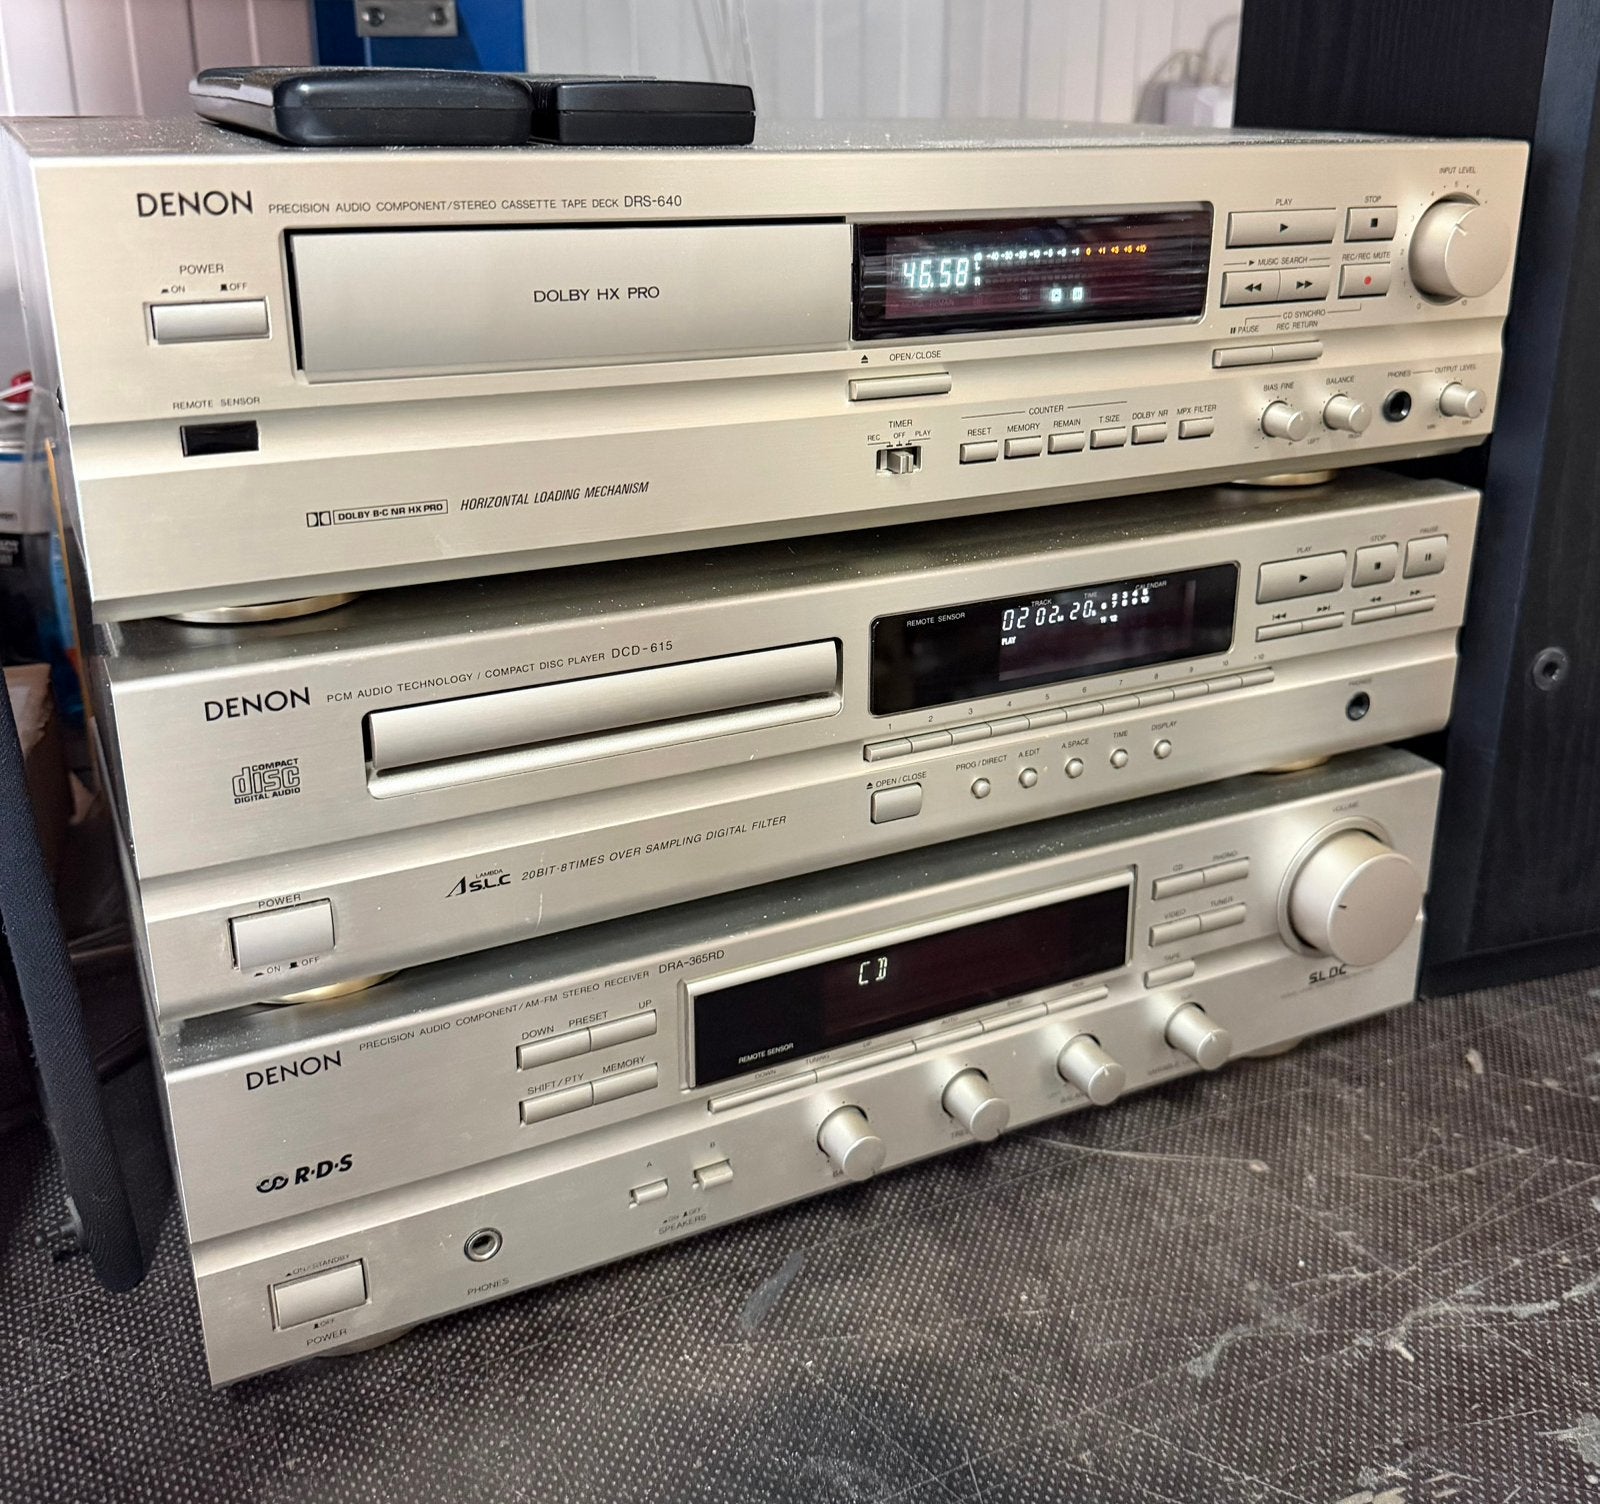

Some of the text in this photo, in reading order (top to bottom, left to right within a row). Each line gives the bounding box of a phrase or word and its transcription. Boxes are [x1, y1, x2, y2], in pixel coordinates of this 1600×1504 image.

[1458, 166, 1477, 174] LEVEL
[136, 190, 254, 218] DENON
[268, 194, 682, 214] PRECISION AUDIO COMPONENT/STEREO CASSETTE TAPE DECK DRS-640
[1275, 198, 1294, 206] PLAY
[1364, 195, 1382, 204] STOP
[1257, 256, 1308, 266] MUSIC SEARCH
[1373, 251, 1391, 259] MUTE
[179, 263, 225, 275] POWER
[902, 257, 970, 289] 46.58
[170, 282, 248, 294] ON OFF
[533, 286, 660, 303] DOLBY HX PRO
[1282, 309, 1326, 320] CD SYNCHRO
[1238, 325, 1259, 334] PAUSE
[1276, 320, 1318, 331] REC RETURN
[889, 350, 942, 361] OPEN/CLOSE
[1387, 370, 1412, 378] PHONES
[1434, 365, 1459, 374] OUTPUT
[1326, 375, 1355, 385] BALANCE
[1263, 382, 1295, 392] BIAS FINE
[172, 396, 261, 411] REMOTE SENSOR
[1028, 404, 1064, 415] COUNTER
[1194, 404, 1217, 413] FILTER
[1132, 409, 1169, 420] DOLBY NR
[889, 419, 913, 428] TIMER
[1007, 422, 1041, 433] MEMORY
[1053, 418, 1081, 428] REMAIN
[967, 427, 992, 437] RESET
[459, 481, 650, 511] HORIZONTAL LOADING MECHANISM
[338, 511, 370, 521] DOLBY
[390, 506, 406, 516] NR
[408, 505, 422, 513] HX
[423, 503, 443, 512] PRO
[1084, 591, 1098, 599] TIME
[1031, 599, 1053, 608] TRACK
[906, 611, 966, 627] REMOTE SENSOR
[1002, 606, 1030, 631] 02
[1001, 636, 1017, 646] PLAY
[326, 690, 353, 703] PCM
[357, 685, 393, 699] AUDIO
[396, 672, 473, 693] TECHNOLOGY
[485, 662, 535, 680] COMPACT
[539, 659, 564, 670] DISC
[568, 652, 606, 666] PLAYER
[204, 686, 311, 723] DENON
[1151, 720, 1178, 731] DISPLAY
[1113, 730, 1128, 739] TIME
[252, 758, 299, 772] COMPACT
[232, 766, 300, 797] disc
[234, 787, 300, 805] DIGITAL AUDIO
[609, 846, 642, 862] OVER
[645, 833, 702, 854] SAMPLING
[706, 823, 748, 841] DIGITAL
[751, 815, 787, 831] FILTER
[475, 868, 504, 879] LAMBDA
[258, 893, 302, 909] POWER
[1210, 896, 1234, 906] TUNER
[1163, 908, 1186, 919] VIDEO
[266, 956, 321, 974] ON OFF
[858, 956, 889, 986] CD
[359, 950, 725, 1052] PRECISION AUDIO COMPONENT/AM-FM STEREO RECEIVER DRA-365RD
[521, 999, 653, 1041] DOWN PRESET UP
[738, 1042, 794, 1065] REMOTE SENSOR
[245, 1050, 342, 1091] DENON
[602, 1055, 646, 1074] MEMORY
[527, 1072, 584, 1095] SHIFT/PTY
[658, 1212, 707, 1235] SPEAKERS
[467, 1276, 510, 1296] PHONES
[306, 1328, 347, 1346] POWER
